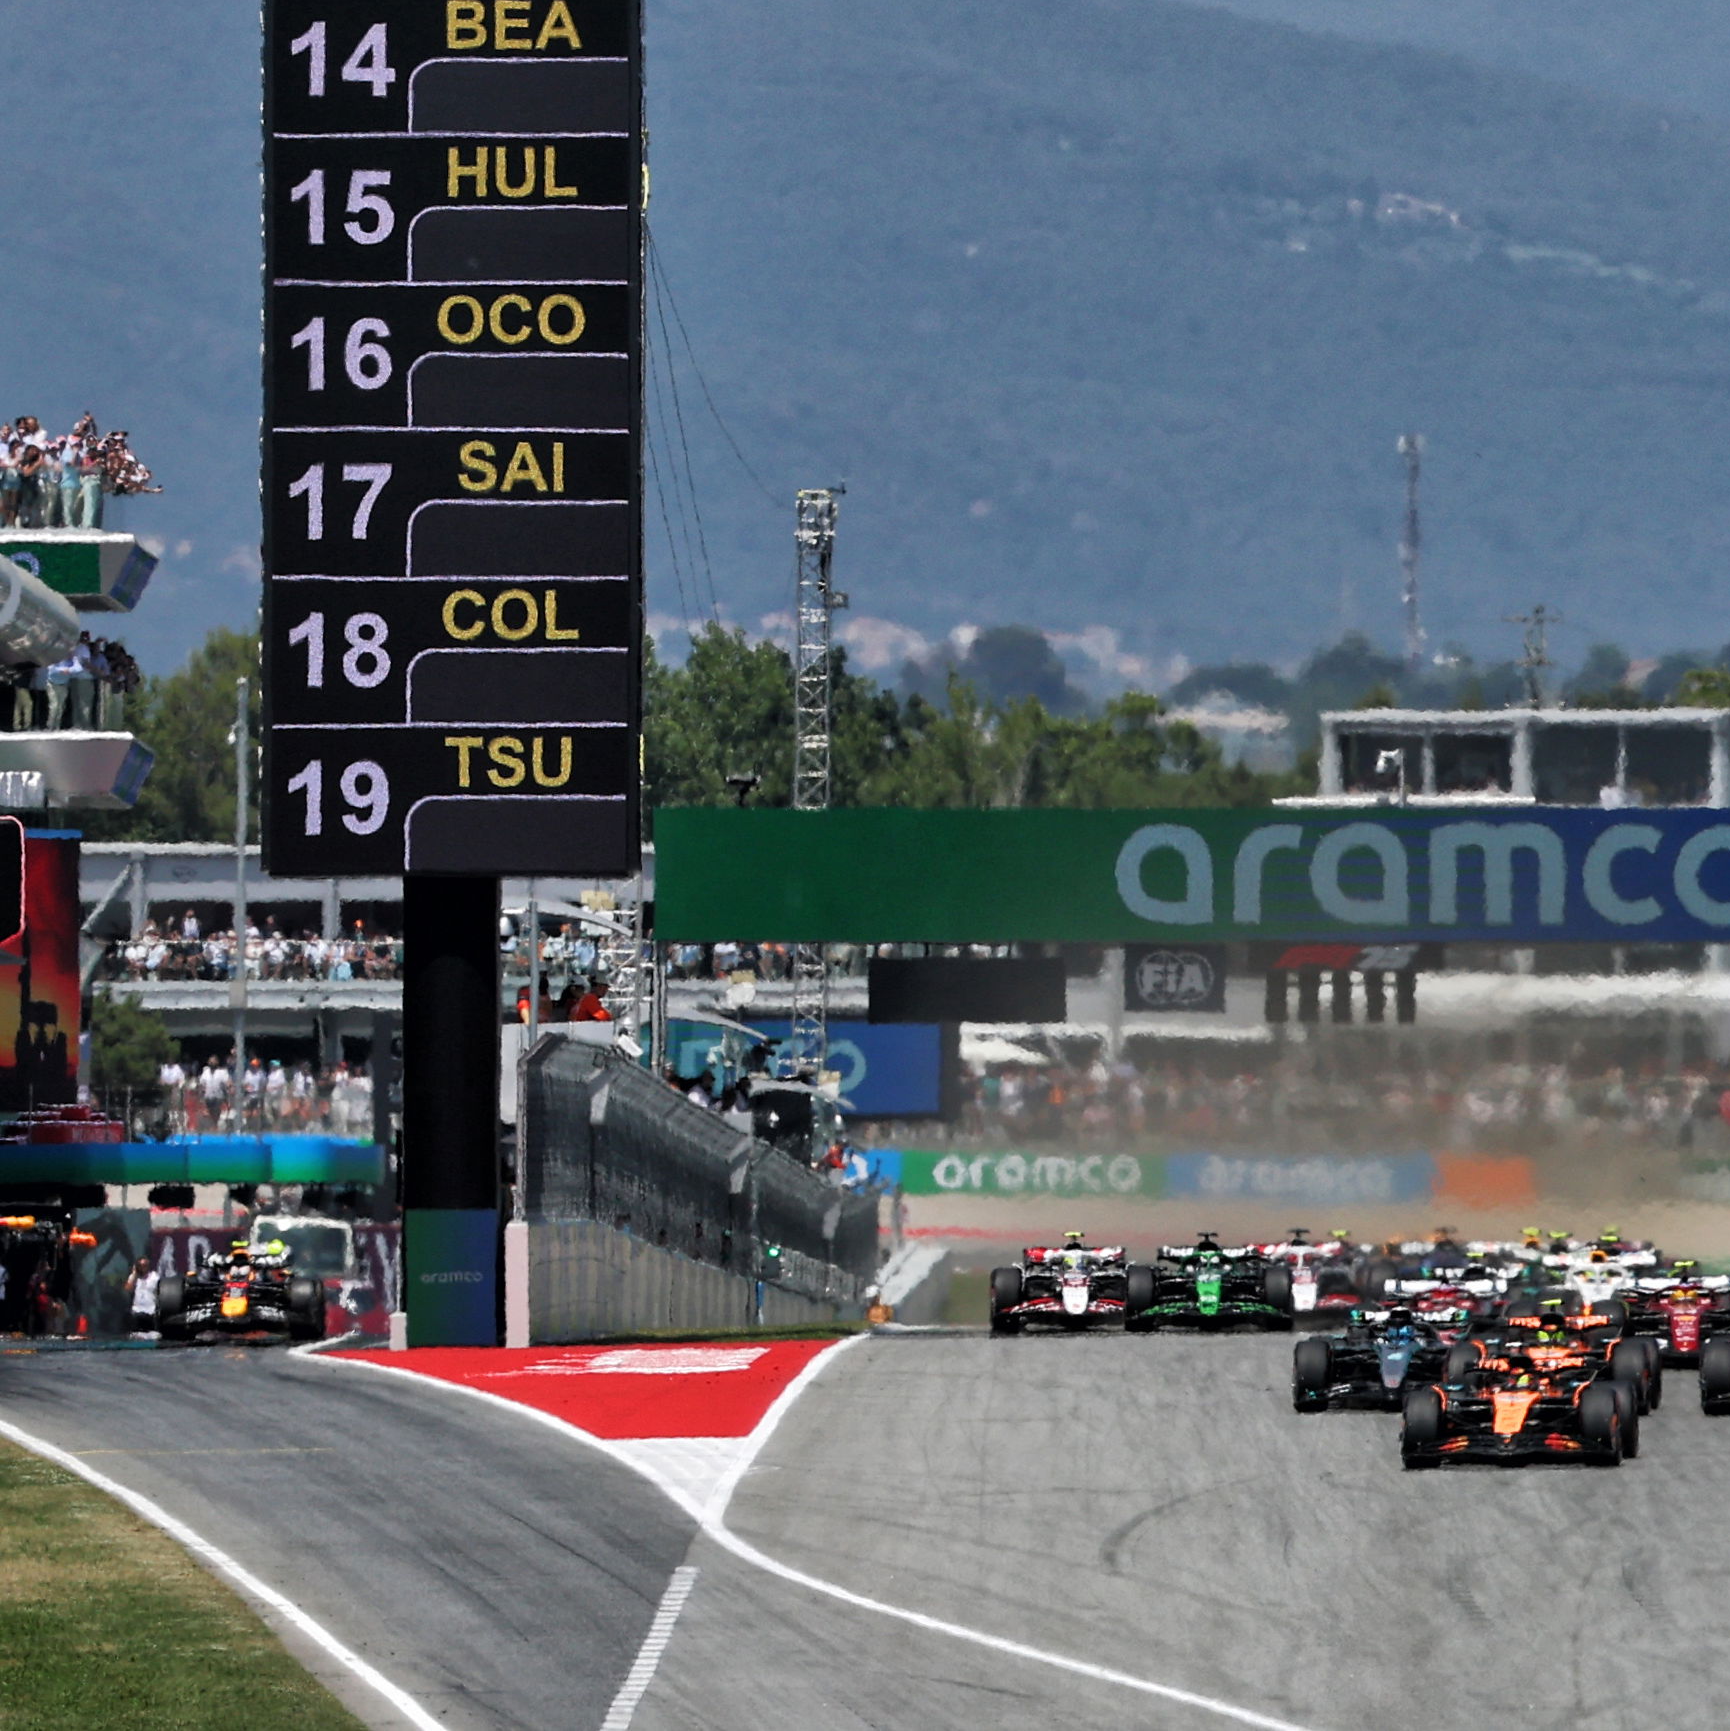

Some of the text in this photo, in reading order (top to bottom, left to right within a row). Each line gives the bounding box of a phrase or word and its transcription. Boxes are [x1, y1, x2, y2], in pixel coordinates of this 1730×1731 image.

[290, 20, 396, 97] 14
[290, 145, 579, 245] 15 HUL
[290, 293, 587, 391] 16 OCO
[288, 439, 565, 541] 17 SAI
[288, 588, 581, 689] 18 COL
[287, 735, 574, 836] 19 TSU
[1141, 962, 1206, 992] FIA
[931, 1153, 1142, 1192] aramco
[420, 1271, 484, 1283] aramco
